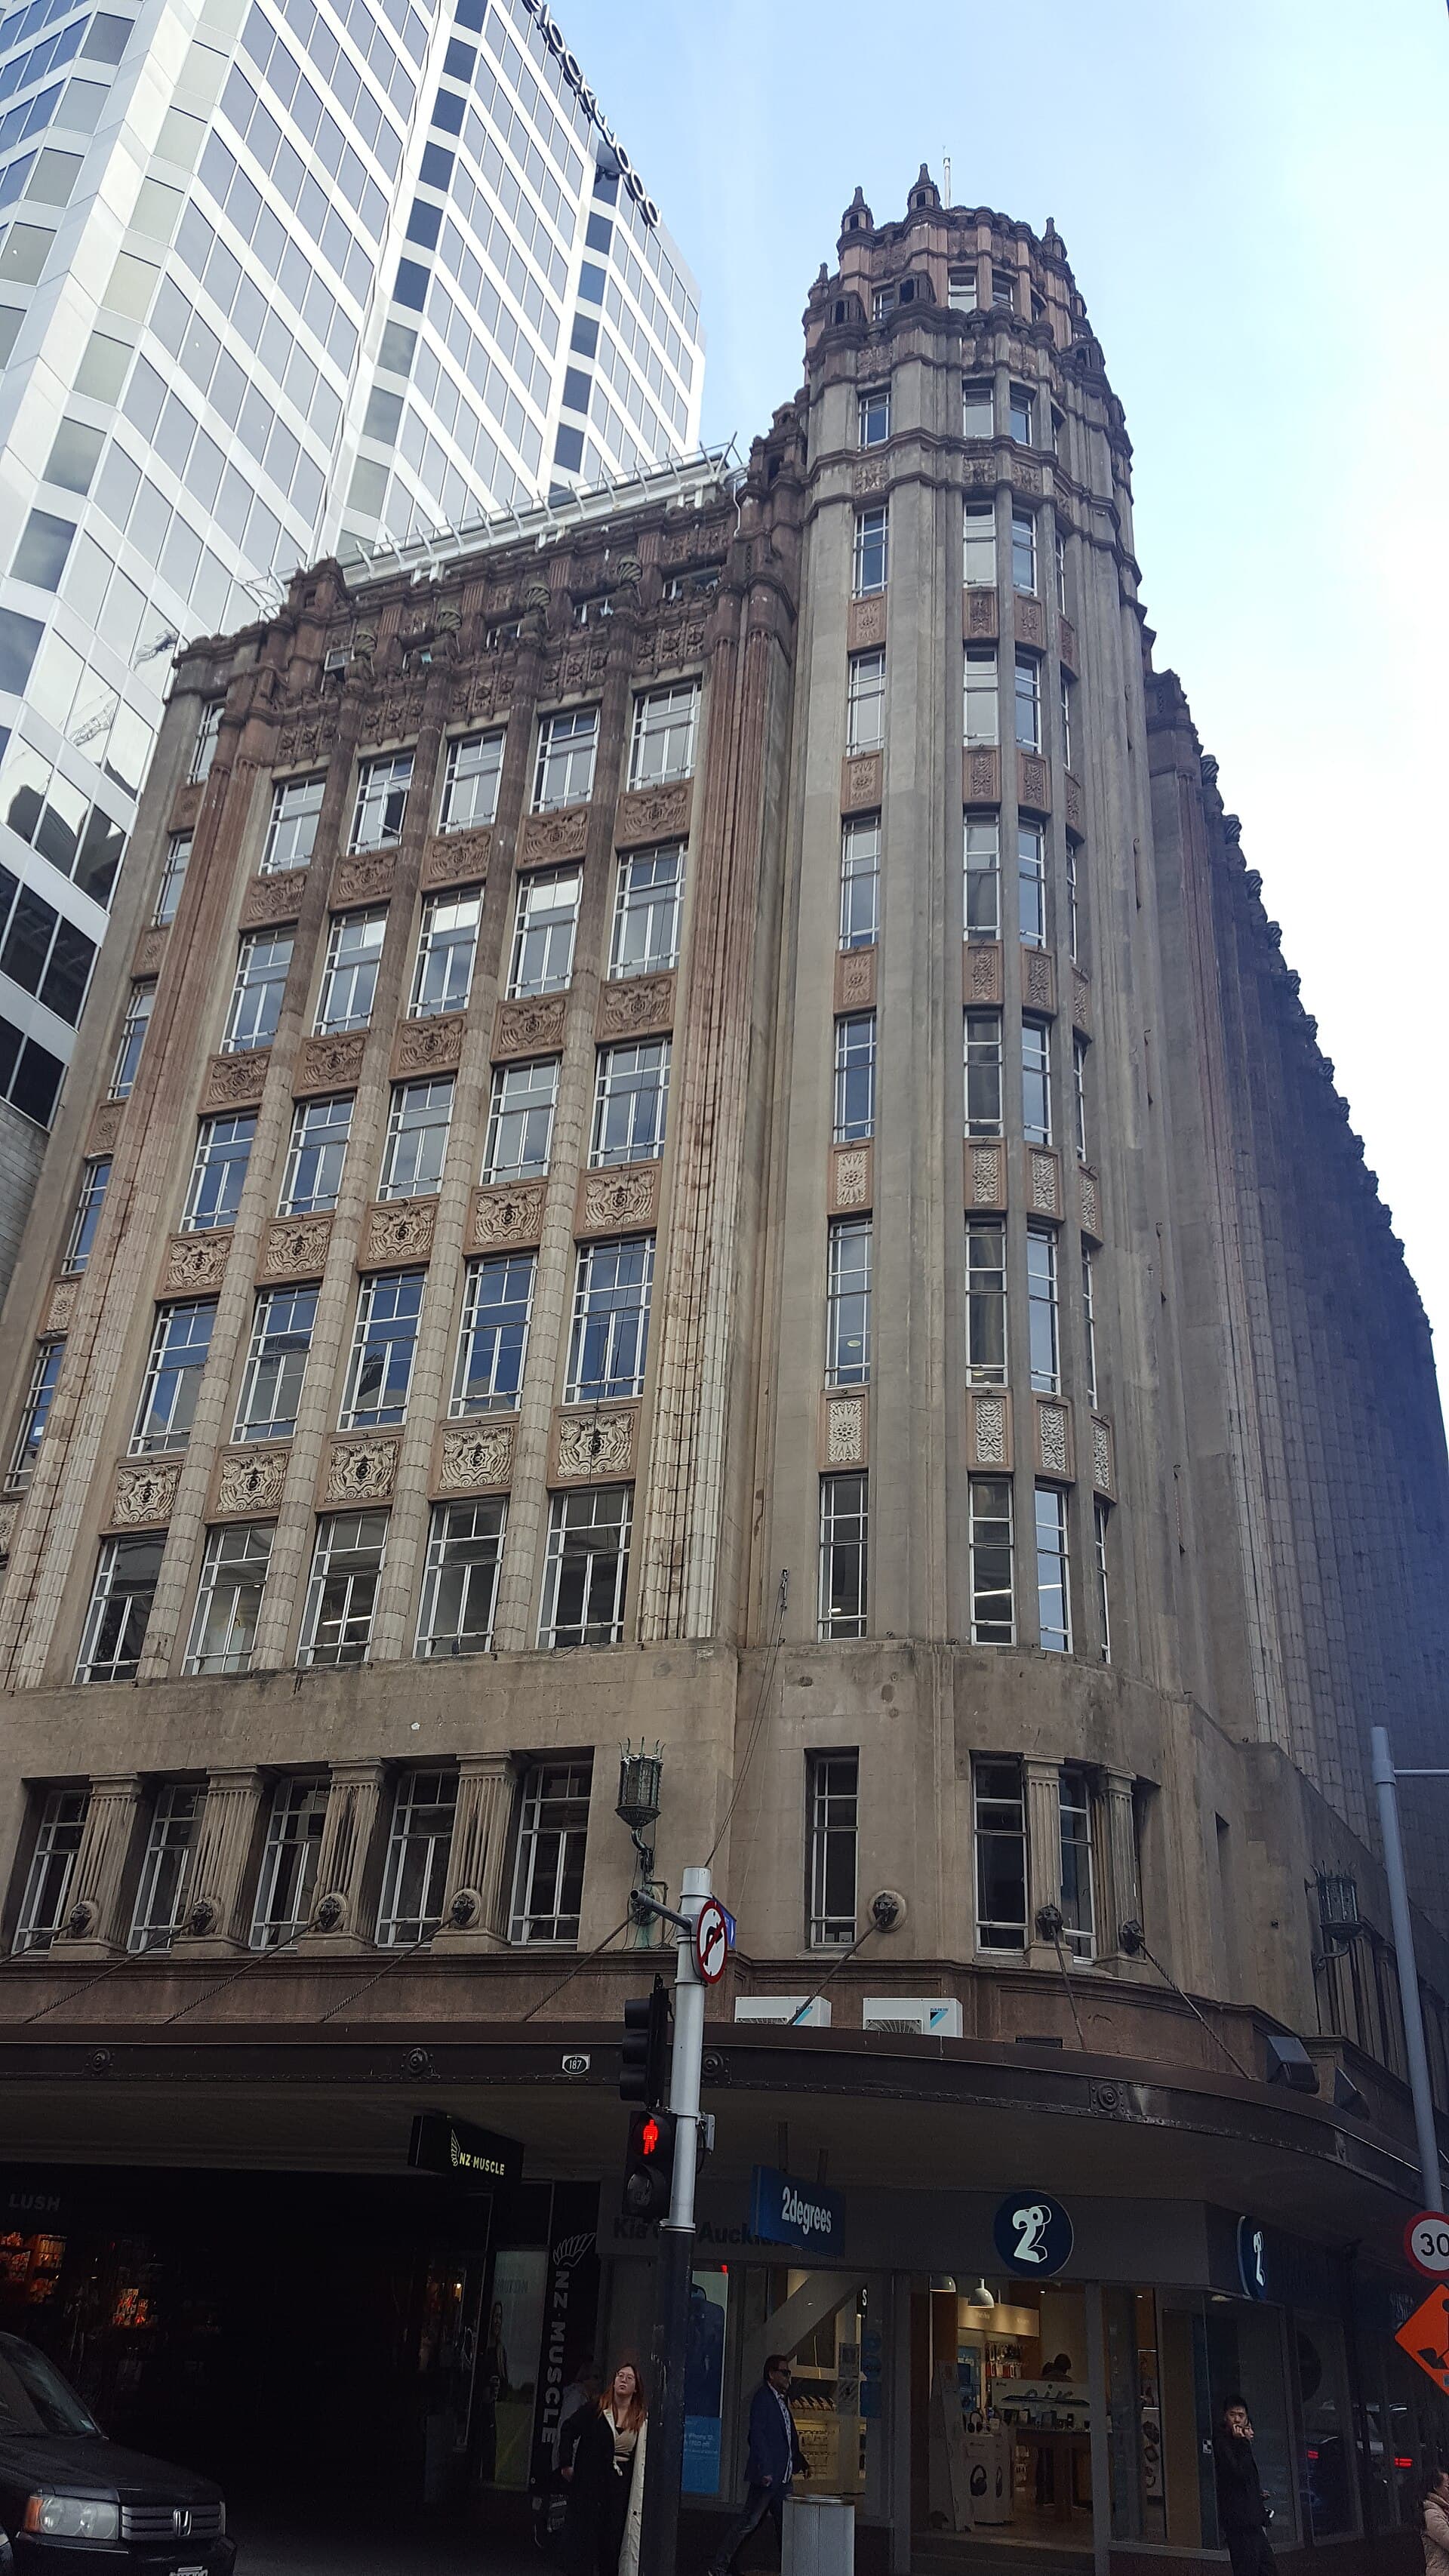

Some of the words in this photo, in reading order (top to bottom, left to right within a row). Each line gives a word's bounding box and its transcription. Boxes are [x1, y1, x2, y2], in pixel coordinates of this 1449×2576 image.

[569, 2059, 582, 2070] 187
[459, 2152, 471, 2166] NZ
[473, 2156, 505, 2175] MUSCLE
[8, 2193, 61, 2211] LUSH
[781, 2186, 832, 2235] 2degrees
[1420, 2233, 1449, 2257] 30
[553, 2270, 570, 2309] NZ
[541, 2321, 567, 2444] MUSCLE
